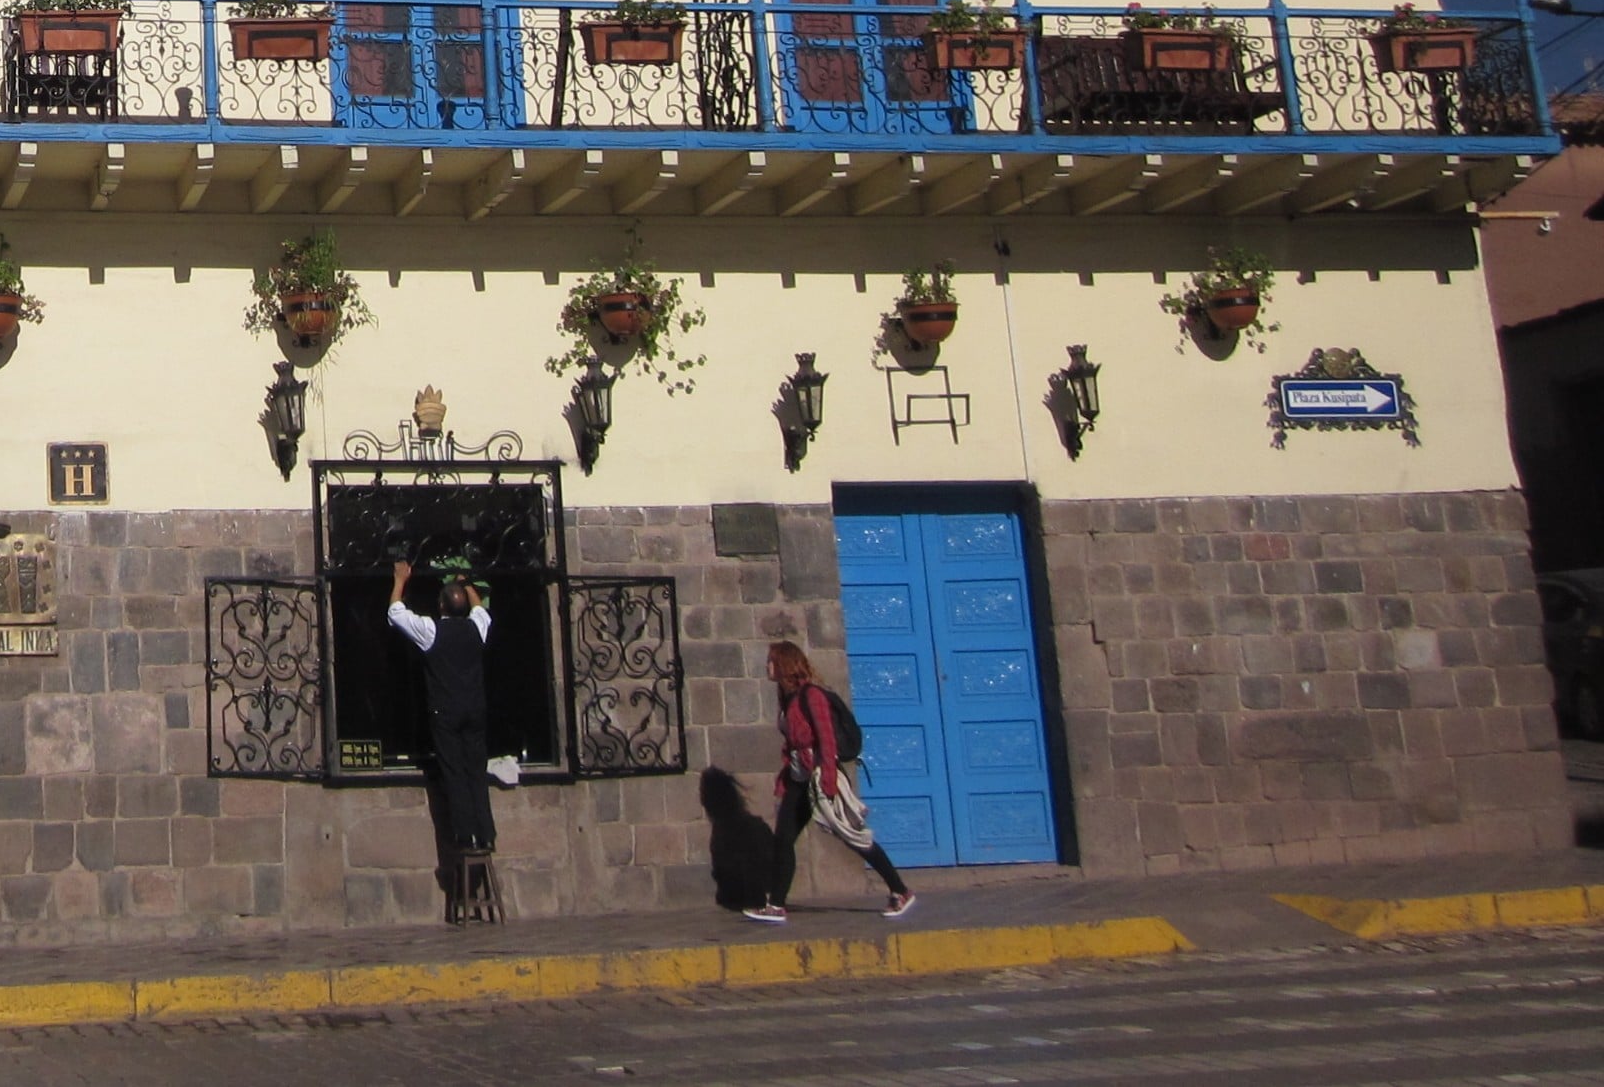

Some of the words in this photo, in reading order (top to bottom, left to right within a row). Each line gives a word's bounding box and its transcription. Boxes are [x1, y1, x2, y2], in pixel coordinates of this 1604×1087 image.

[1293, 391, 1320, 403] Plaza
[1322, 391, 1366, 405] Kusipata
[62, 464, 95, 496] H
[21, 630, 52, 652] INKA
